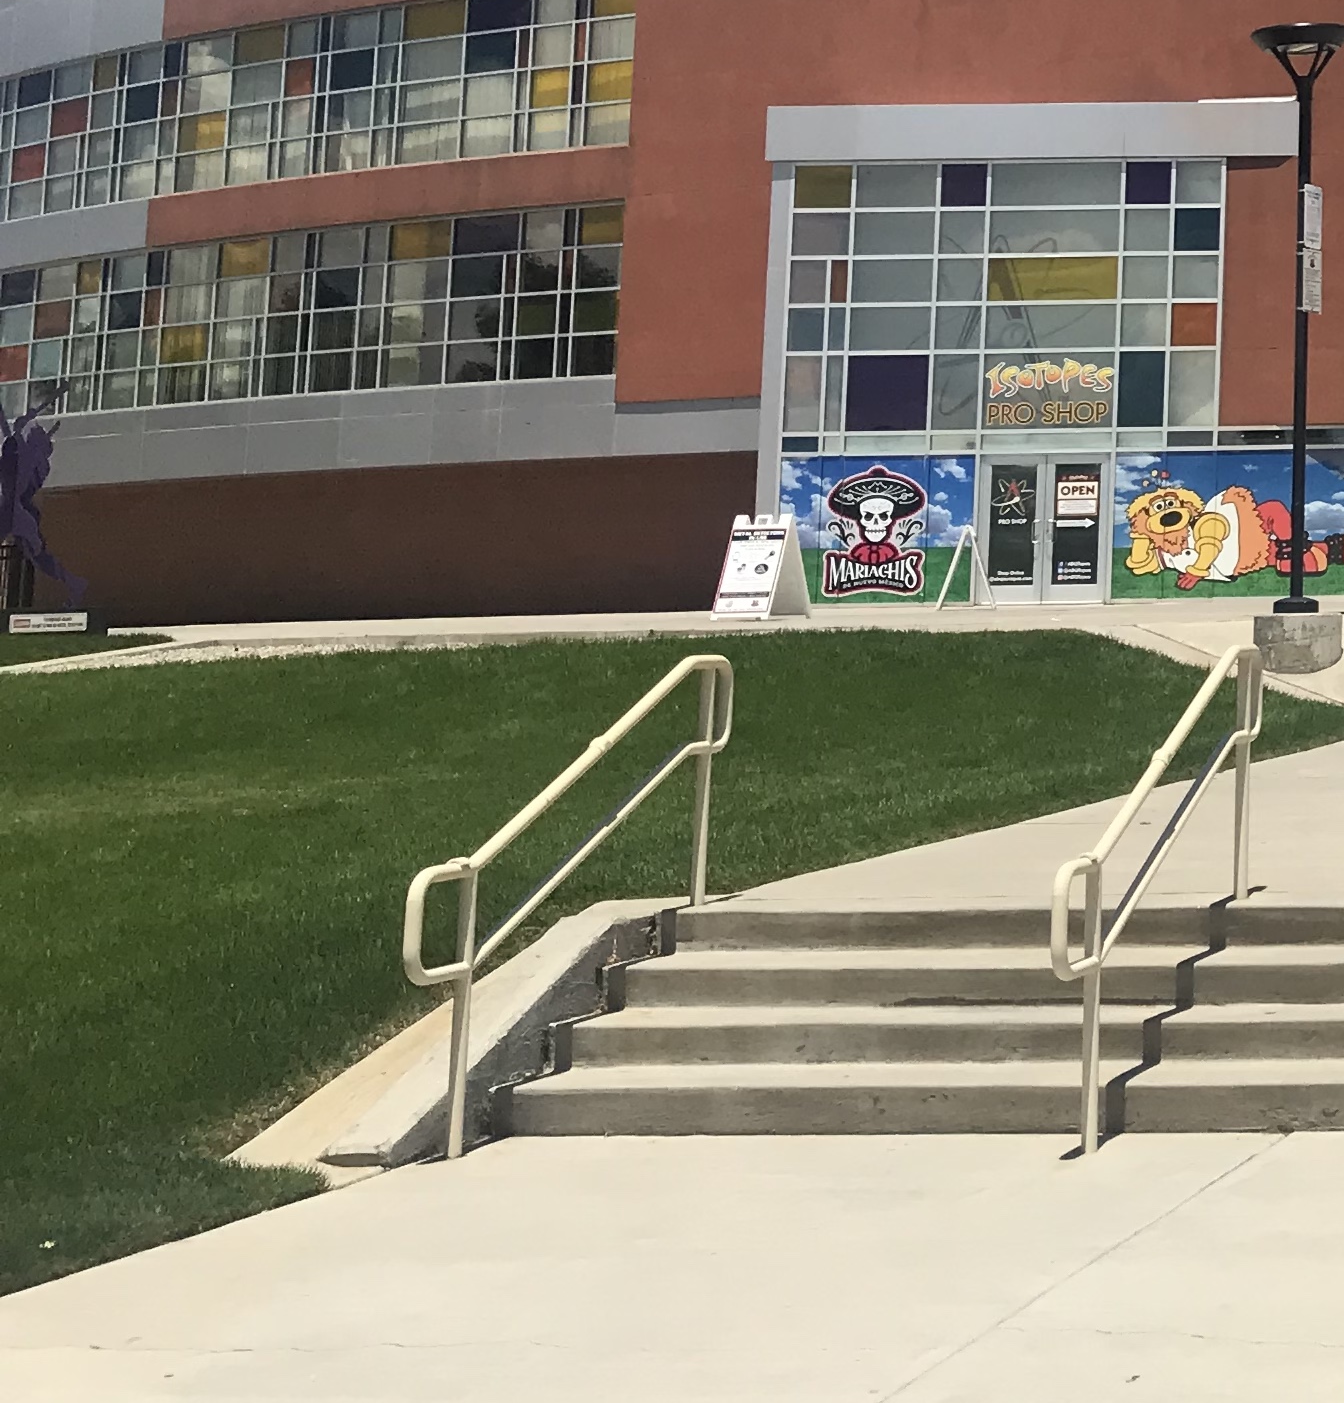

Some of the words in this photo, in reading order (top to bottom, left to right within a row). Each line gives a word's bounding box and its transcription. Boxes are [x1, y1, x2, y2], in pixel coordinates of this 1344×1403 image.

[985, 358, 1115, 398] ISOTOPES
[986, 401, 1036, 425] PRO
[1041, 400, 1108, 425] SHOP
[1060, 485, 1095, 496] OPEN
[828, 555, 918, 591] MARIACHIS
